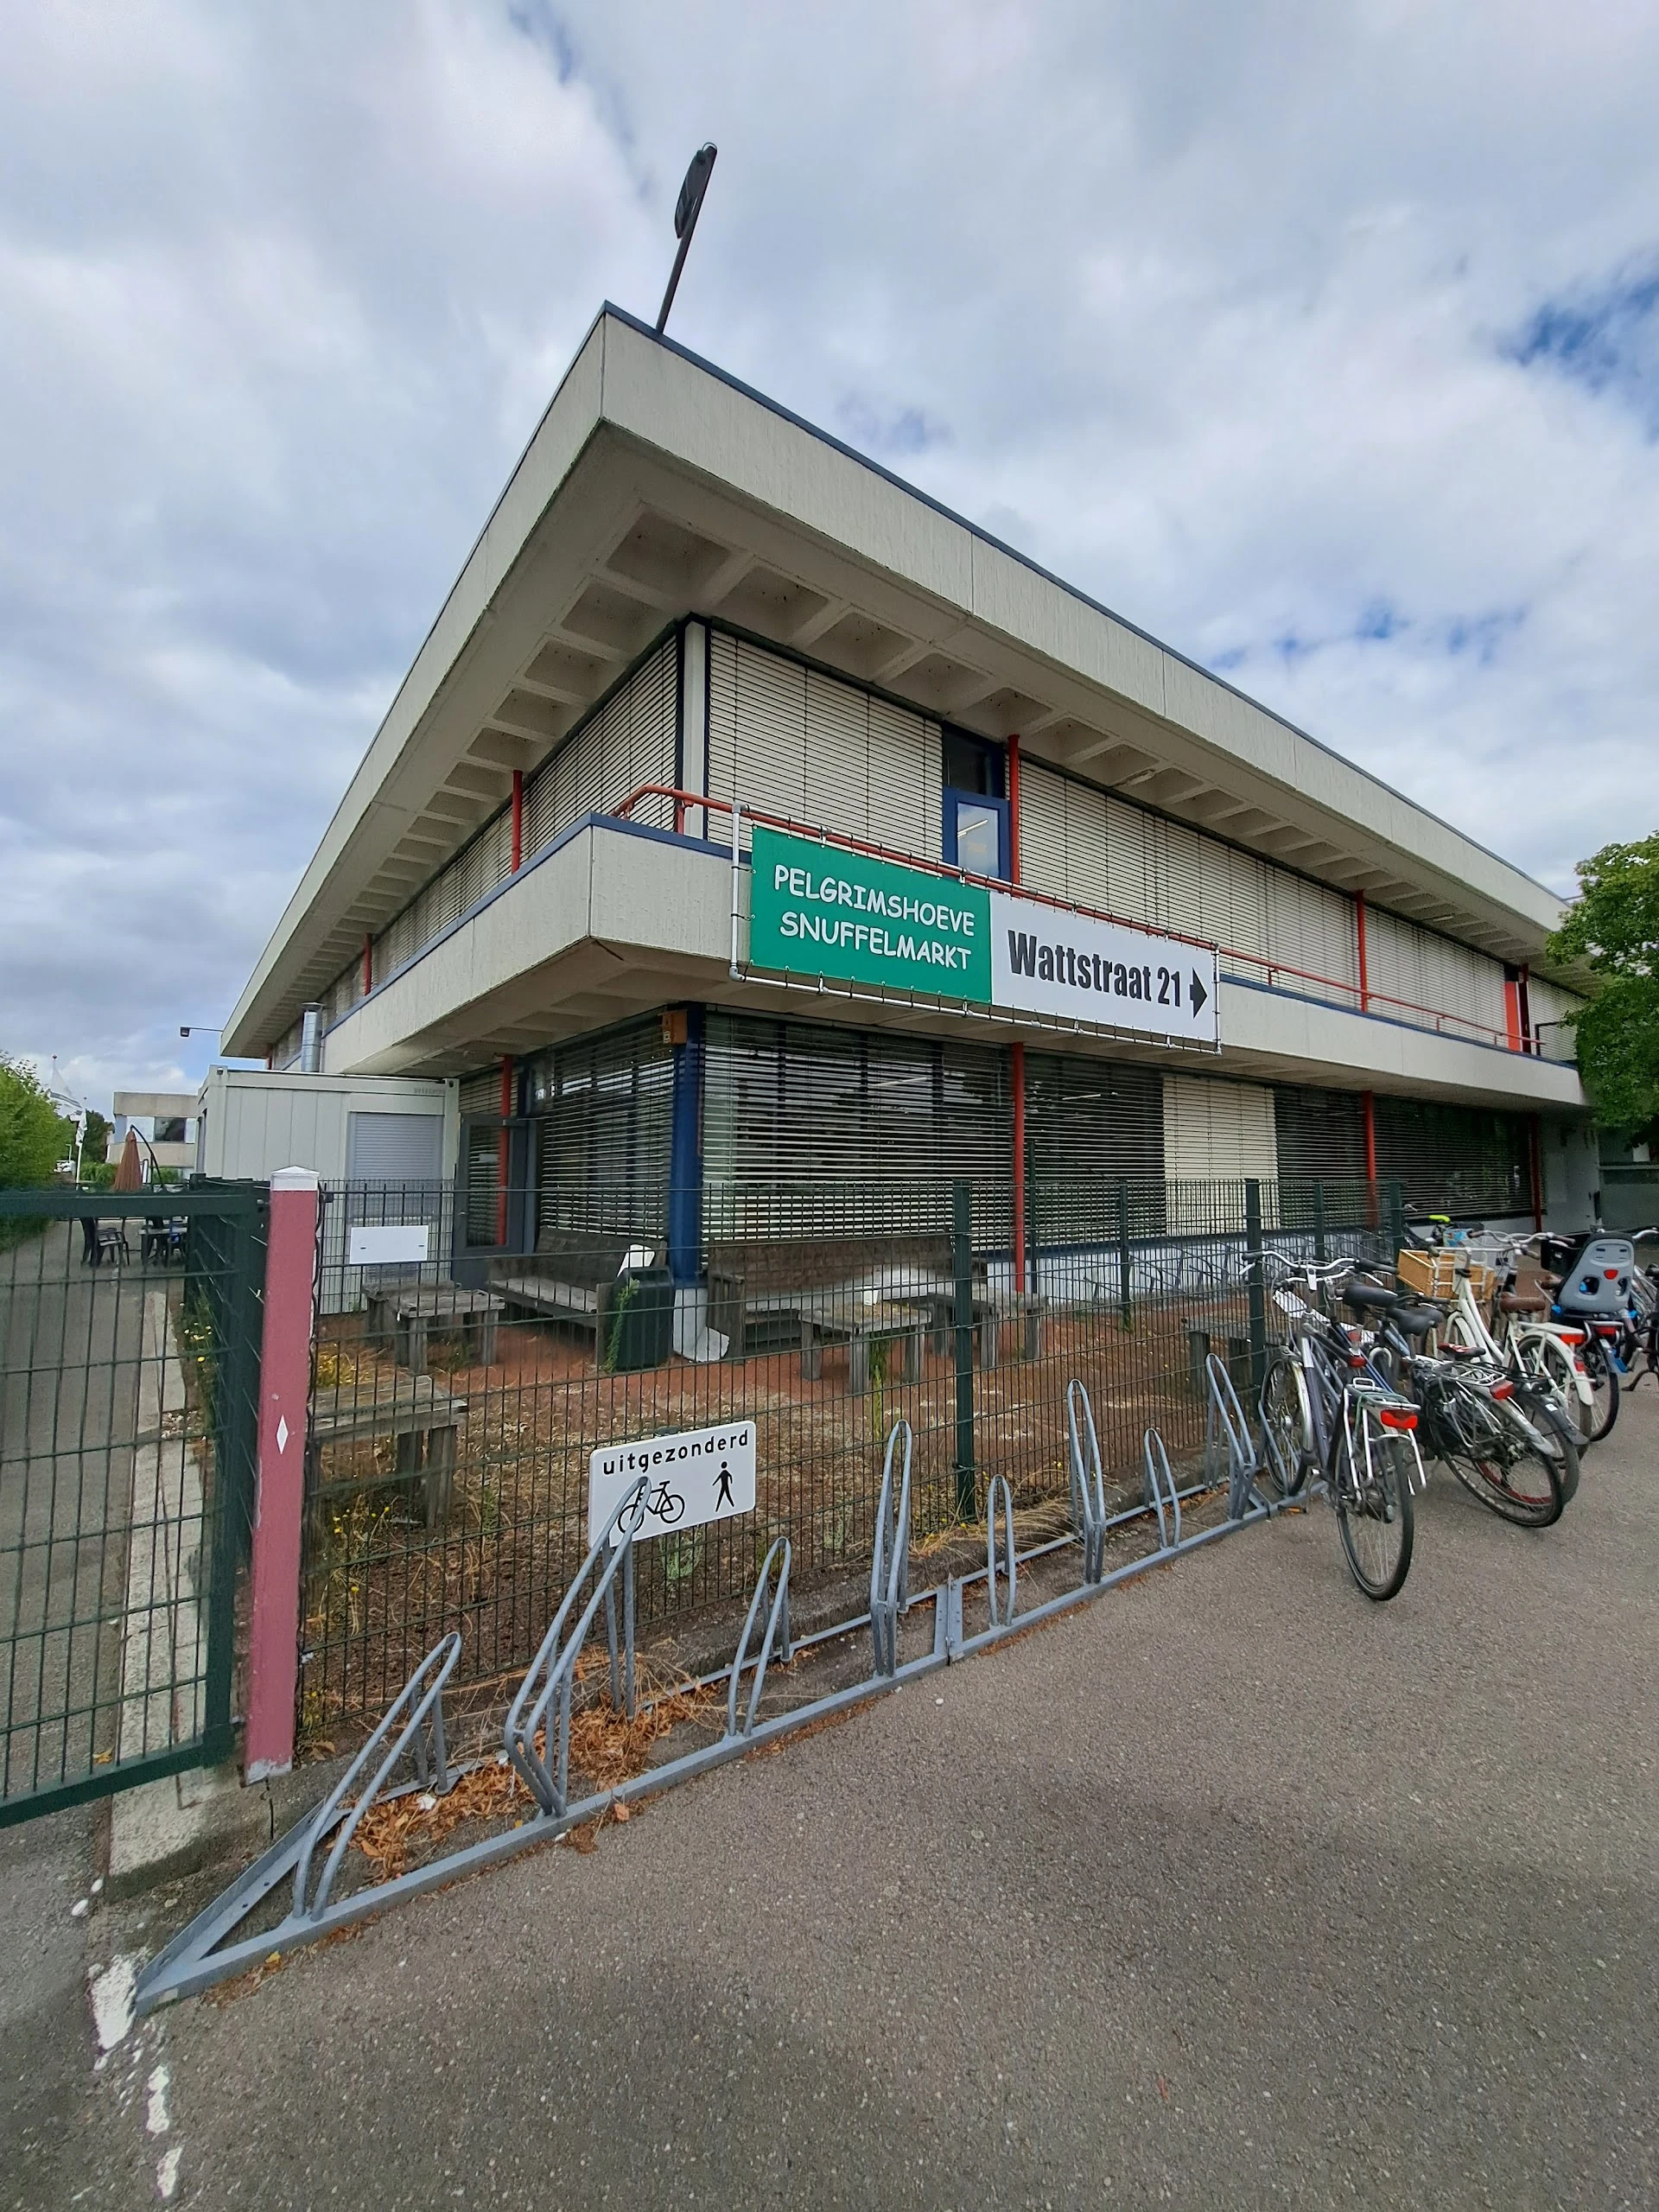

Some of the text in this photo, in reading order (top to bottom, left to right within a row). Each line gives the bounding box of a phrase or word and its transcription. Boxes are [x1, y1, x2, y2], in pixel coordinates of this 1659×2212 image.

[774, 864, 975, 937] PELGRIMSHOEVE
[779, 911, 972, 970] SNUFFELMARKT
[1007, 929, 1180, 1007] Wattstraat 21
[603, 1428, 748, 1475] uitgezonderd
